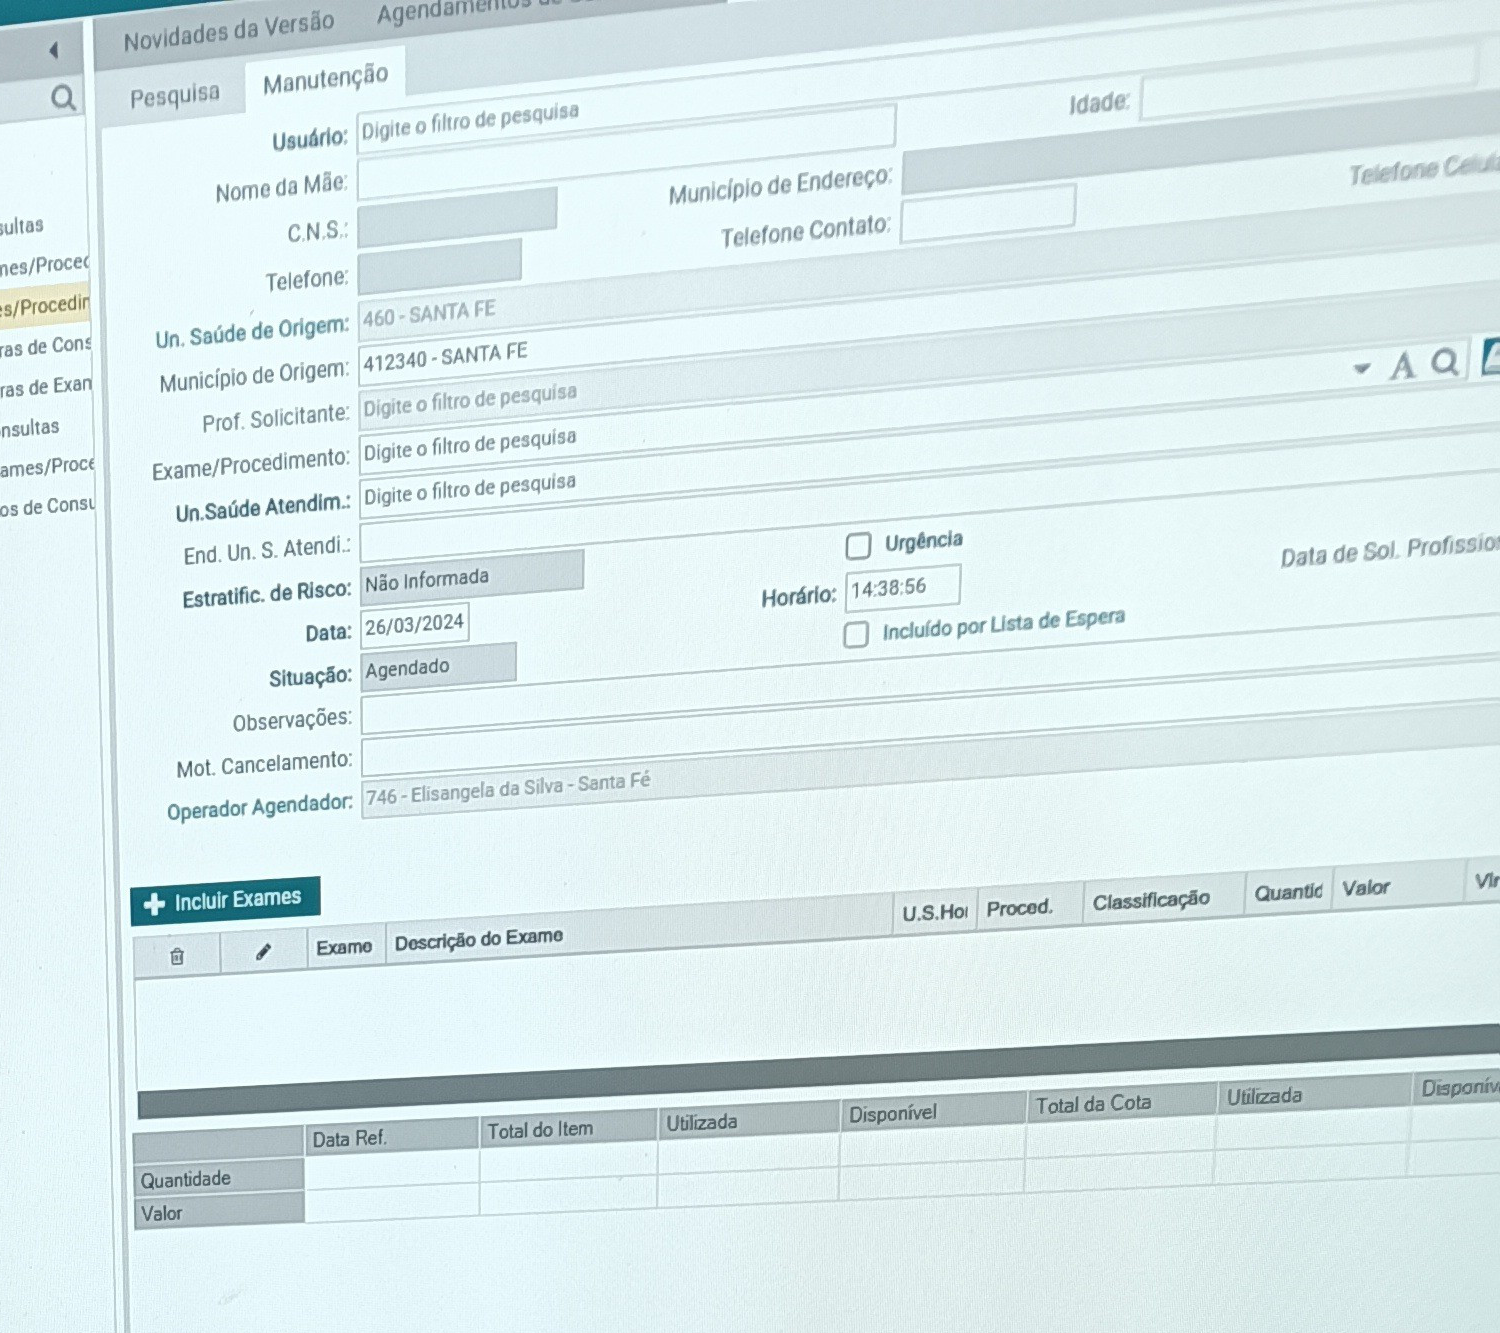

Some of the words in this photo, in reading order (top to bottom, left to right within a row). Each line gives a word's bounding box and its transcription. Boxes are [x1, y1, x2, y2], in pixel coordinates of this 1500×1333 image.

[123, 24, 228, 53] Novidades
[235, 20, 258, 39] da
[264, 11, 334, 35] Versão
[263, 64, 389, 95] Manutenção
[130, 83, 220, 109] Pesquisa
[1068, 90, 1131, 116] Idade:
[272, 127, 349, 152] Usuário:
[362, 119, 411, 142] Digite
[415, 119, 427, 134] o
[431, 112, 471, 131] filtro
[475, 109, 497, 128] de
[502, 101, 580, 130] pesquisa
[215, 180, 271, 203] Nome
[275, 178, 298, 196] da
[303, 172, 348, 194] Mãe:
[160, 366, 247, 393] Município
[252, 365, 275, 384] de
[280, 360, 350, 384] Origem:
[363, 350, 427, 373] 412340
[441, 345, 502, 366] SANTA
[506, 342, 528, 360] FE
[202, 413, 246, 432] Prof.
[251, 404, 350, 428] Solicitante:
[152, 449, 350, 479] Exame/Procedimento:
[176, 498, 260, 523] Un.Saúde
[265, 492, 351, 516] Atendim.:
[885, 529, 964, 555] Urgência
[852, 577, 928, 598] 14:38:56
[306, 623, 352, 643] Data:
[365, 613, 464, 636] 26/03/2024
[269, 666, 352, 691] Situação:
[365, 657, 450, 681] Agendado
[233, 708, 352, 735] Observações:
[168, 798, 247, 825] Operador
[251, 794, 353, 820] Agendador:
[175, 892, 229, 912] Incluir
[233, 887, 302, 907] Exames
[849, 1104, 938, 1125] Disponível
[1035, 1096, 1079, 1115] Total
[1083, 1095, 1105, 1113] da
[1109, 1093, 1152, 1112] Cota
[140, 1168, 231, 1191] Quantidade
[142, 1205, 183, 1223] Valor
